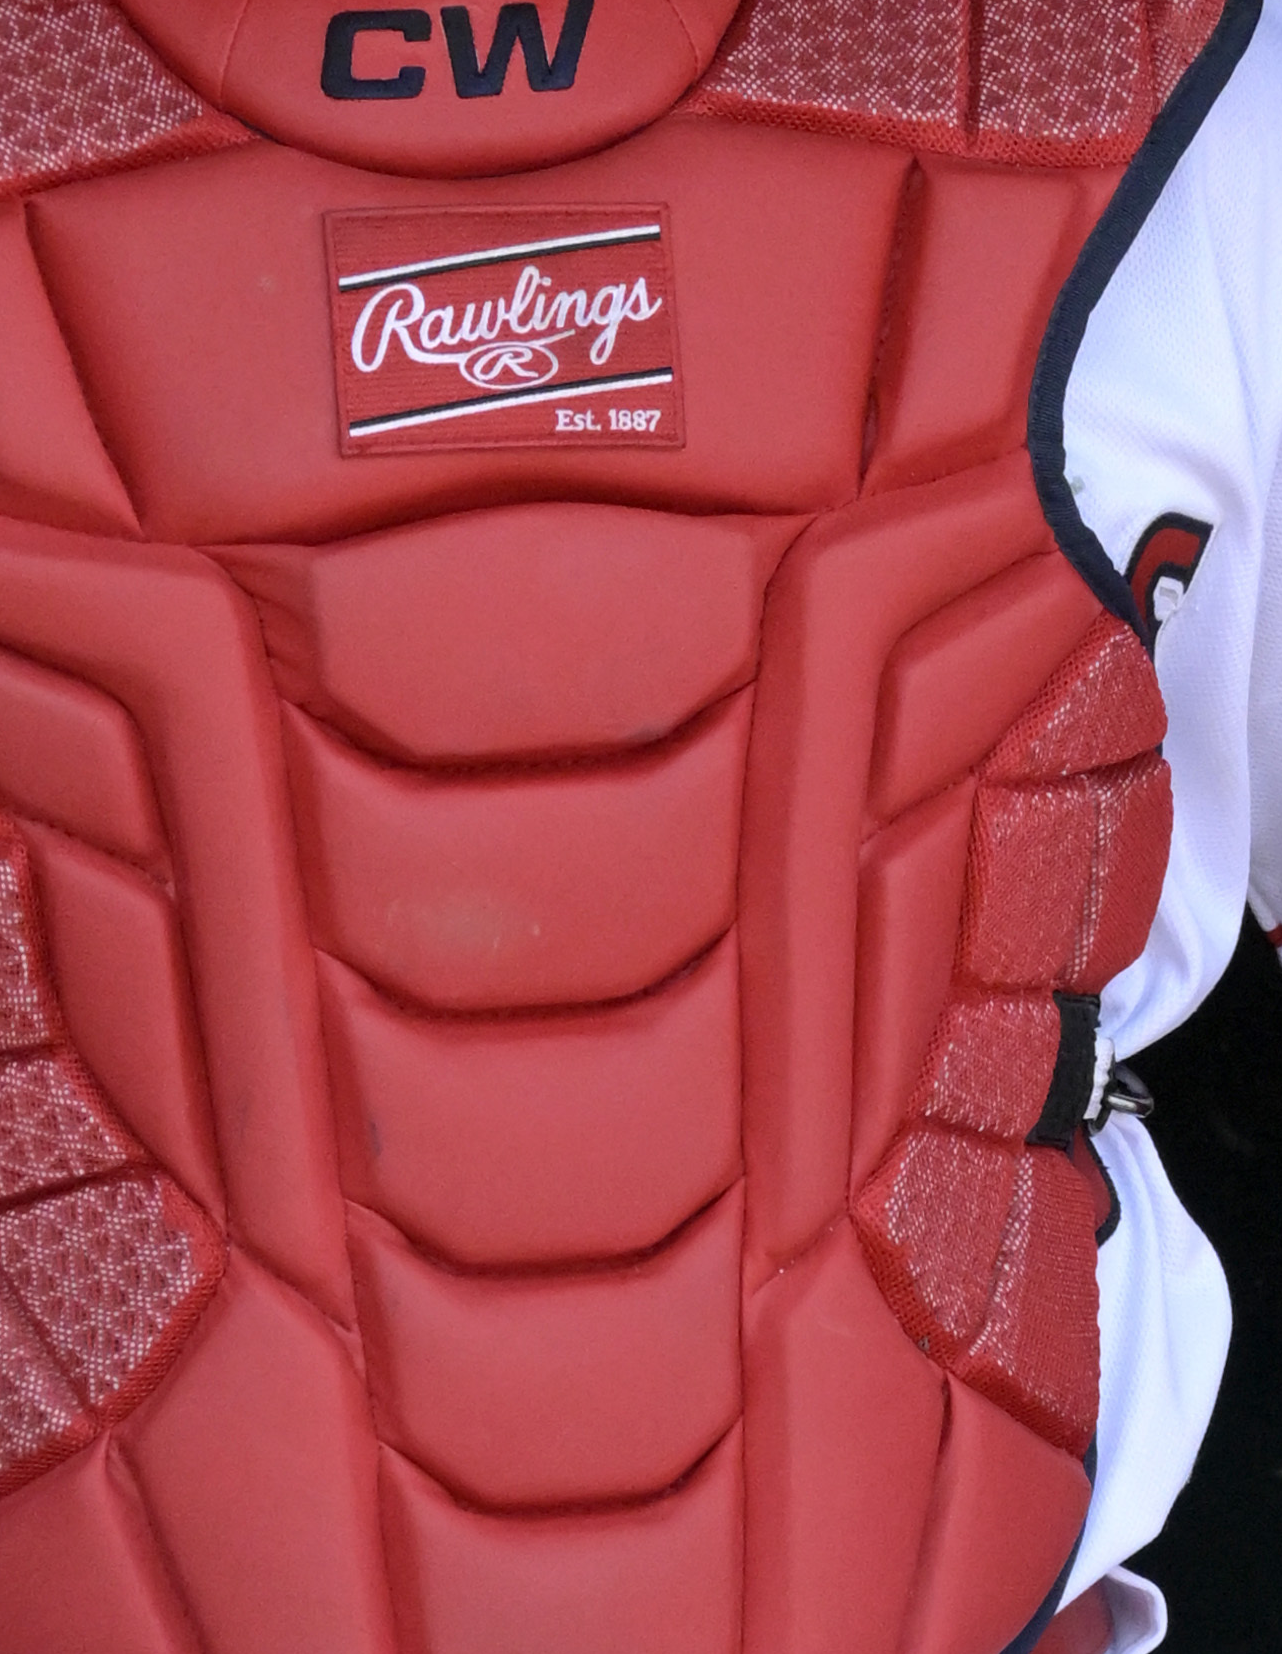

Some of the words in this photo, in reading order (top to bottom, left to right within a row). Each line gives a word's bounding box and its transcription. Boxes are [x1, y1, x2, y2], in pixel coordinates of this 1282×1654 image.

[351, 265, 663, 374] Rawlings
[556, 410, 601, 433] Est.
[609, 409, 662, 433] 1887
